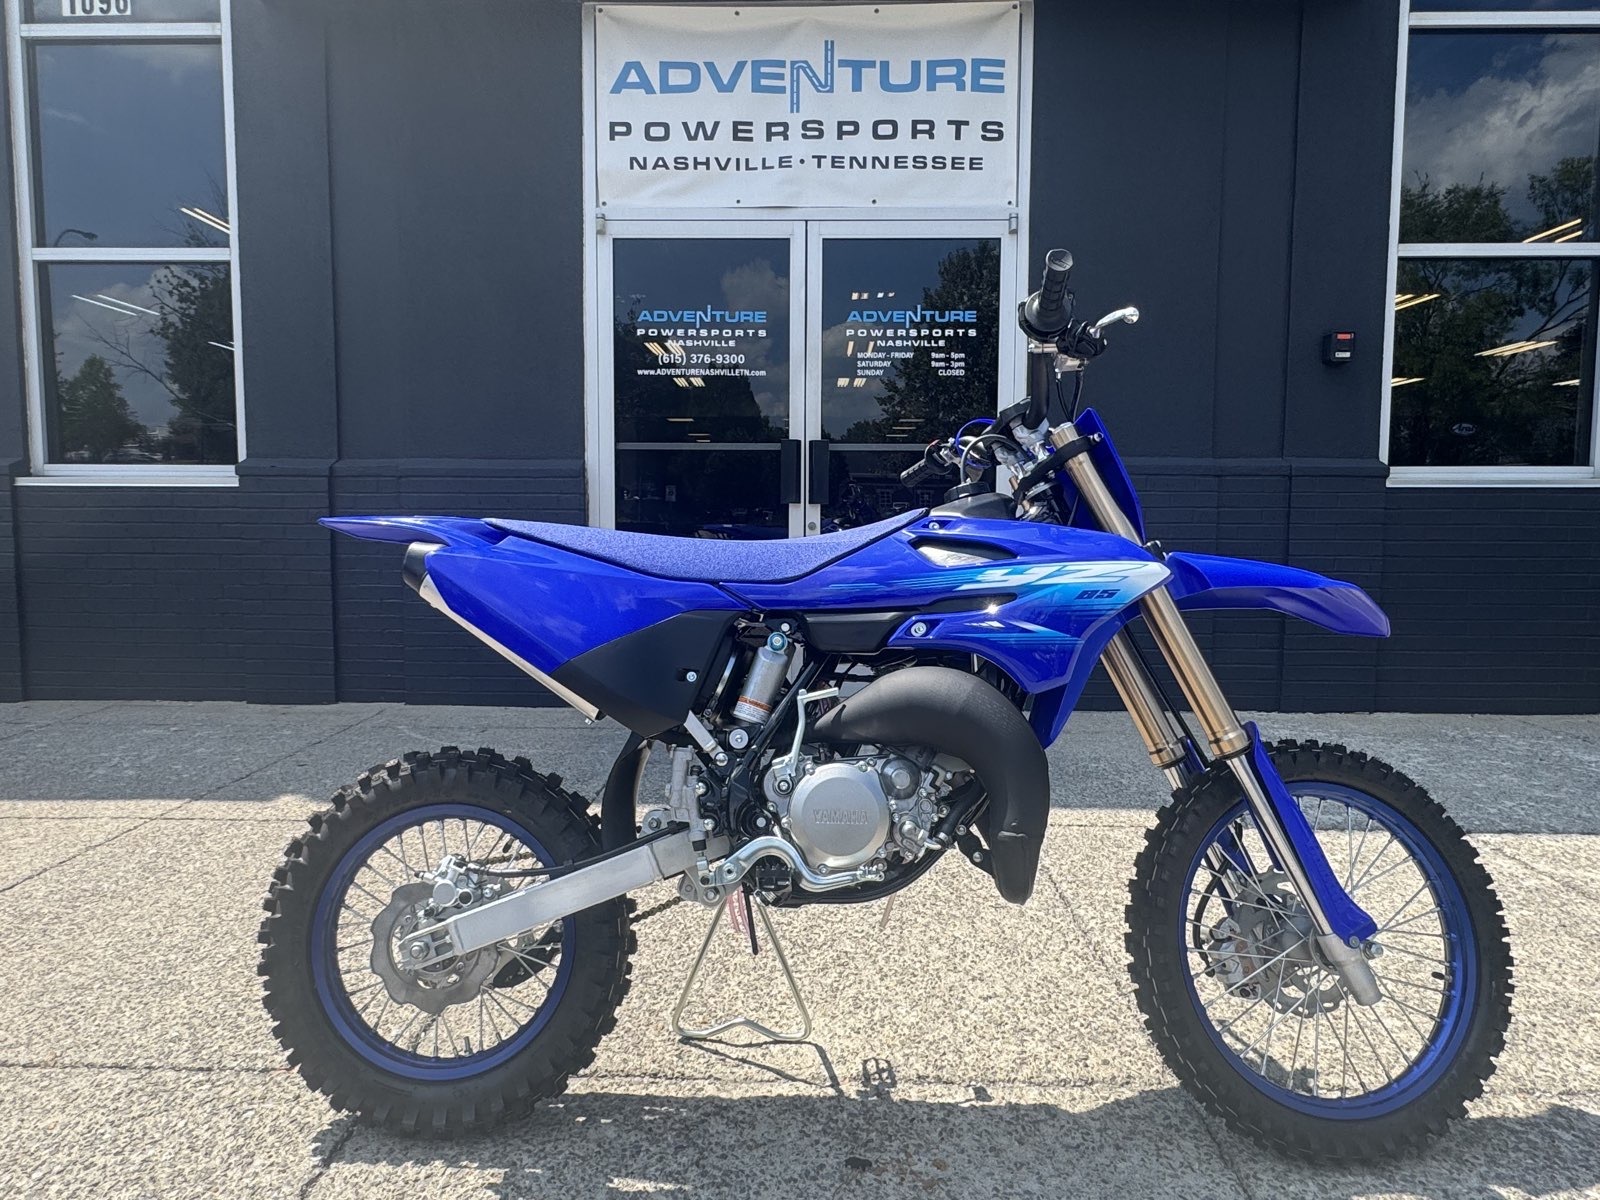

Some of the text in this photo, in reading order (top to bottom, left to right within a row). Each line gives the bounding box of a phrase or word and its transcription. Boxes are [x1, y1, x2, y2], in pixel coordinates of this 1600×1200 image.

[609, 40, 1006, 113] ADVENTURE
[609, 119, 1005, 142] POWERSPORTS
[629, 155, 793, 171] NASHVILLE
[811, 155, 984, 171] TENNESSEE
[637, 305, 767, 328] ADVENTURE
[846, 304, 977, 328] ADVENTURE
[637, 328, 767, 337] POWERSPORTS
[846, 329, 977, 337] POWERSPORTS
[658, 353, 745, 365] (615) 376-9300
[950, 352, 965, 360] 5pm
[637, 368, 767, 377] www.ADVENTURENASHVILLETN.com
[1075, 589, 1121, 600] 85
[813, 808, 868, 825] YAMAHA
